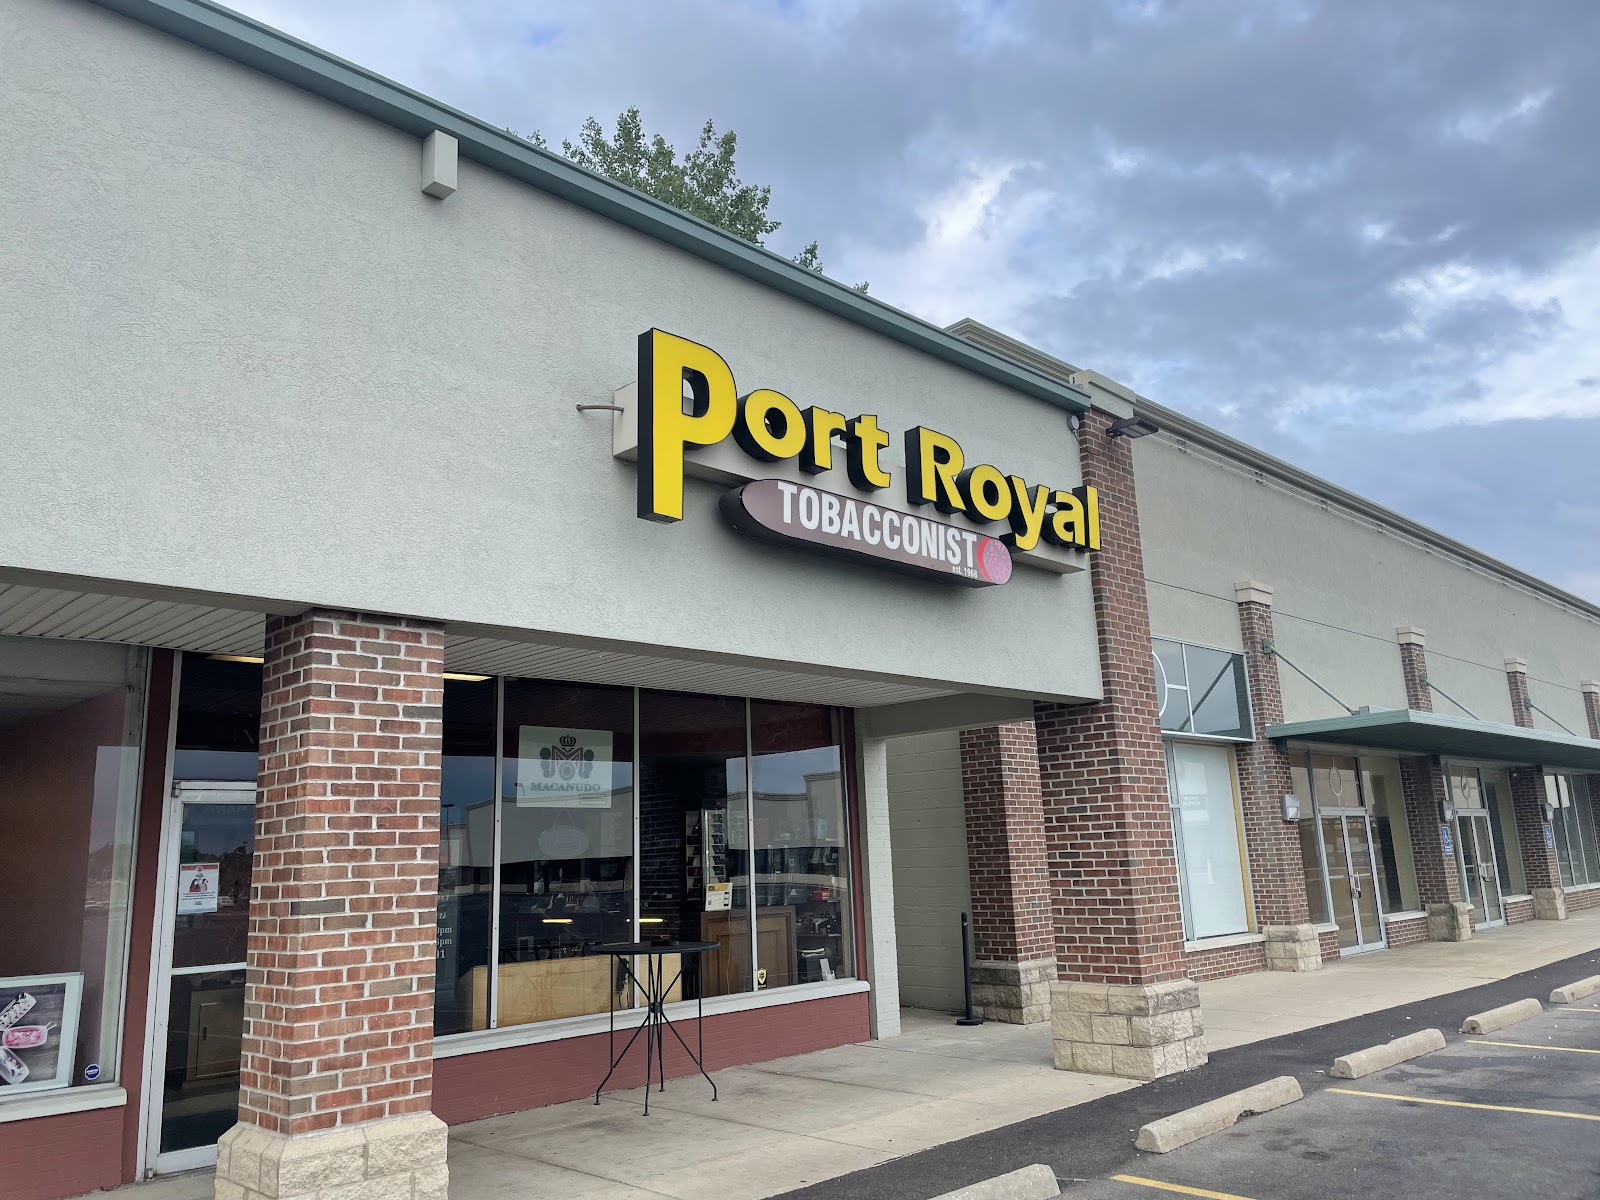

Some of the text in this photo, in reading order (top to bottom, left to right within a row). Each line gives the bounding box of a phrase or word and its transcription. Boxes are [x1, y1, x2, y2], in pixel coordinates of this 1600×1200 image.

[637, 328, 1101, 553] Port Royal
[777, 481, 977, 568] TOBACCONIST
[952, 565, 963, 575] est.
[530, 782, 600, 792] MACANUDO
